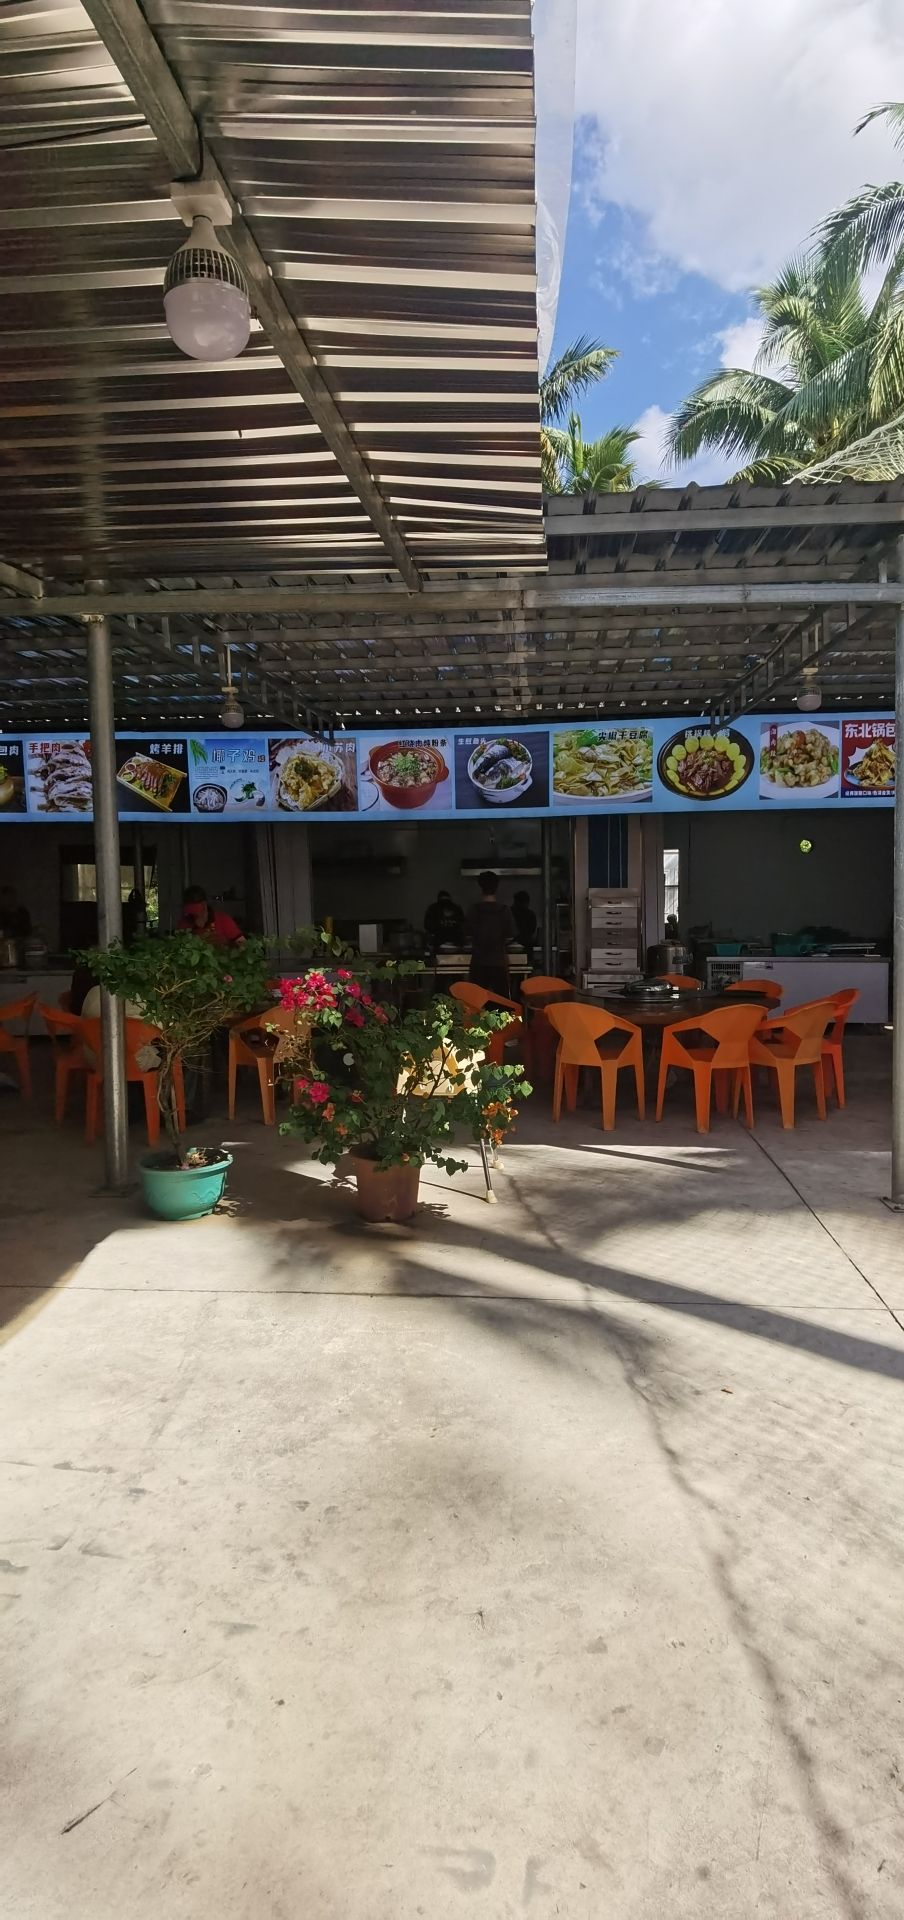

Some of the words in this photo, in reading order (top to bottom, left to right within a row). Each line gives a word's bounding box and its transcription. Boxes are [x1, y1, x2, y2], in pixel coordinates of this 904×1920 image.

[598, 730, 648, 741] 尖椒干豆腐
[845, 722, 896, 738] 东北锅包
[29, 742, 61, 754] 手把肉
[149, 743, 184, 755] 烤羊排
[212, 749, 256, 762] 椰子鸡
